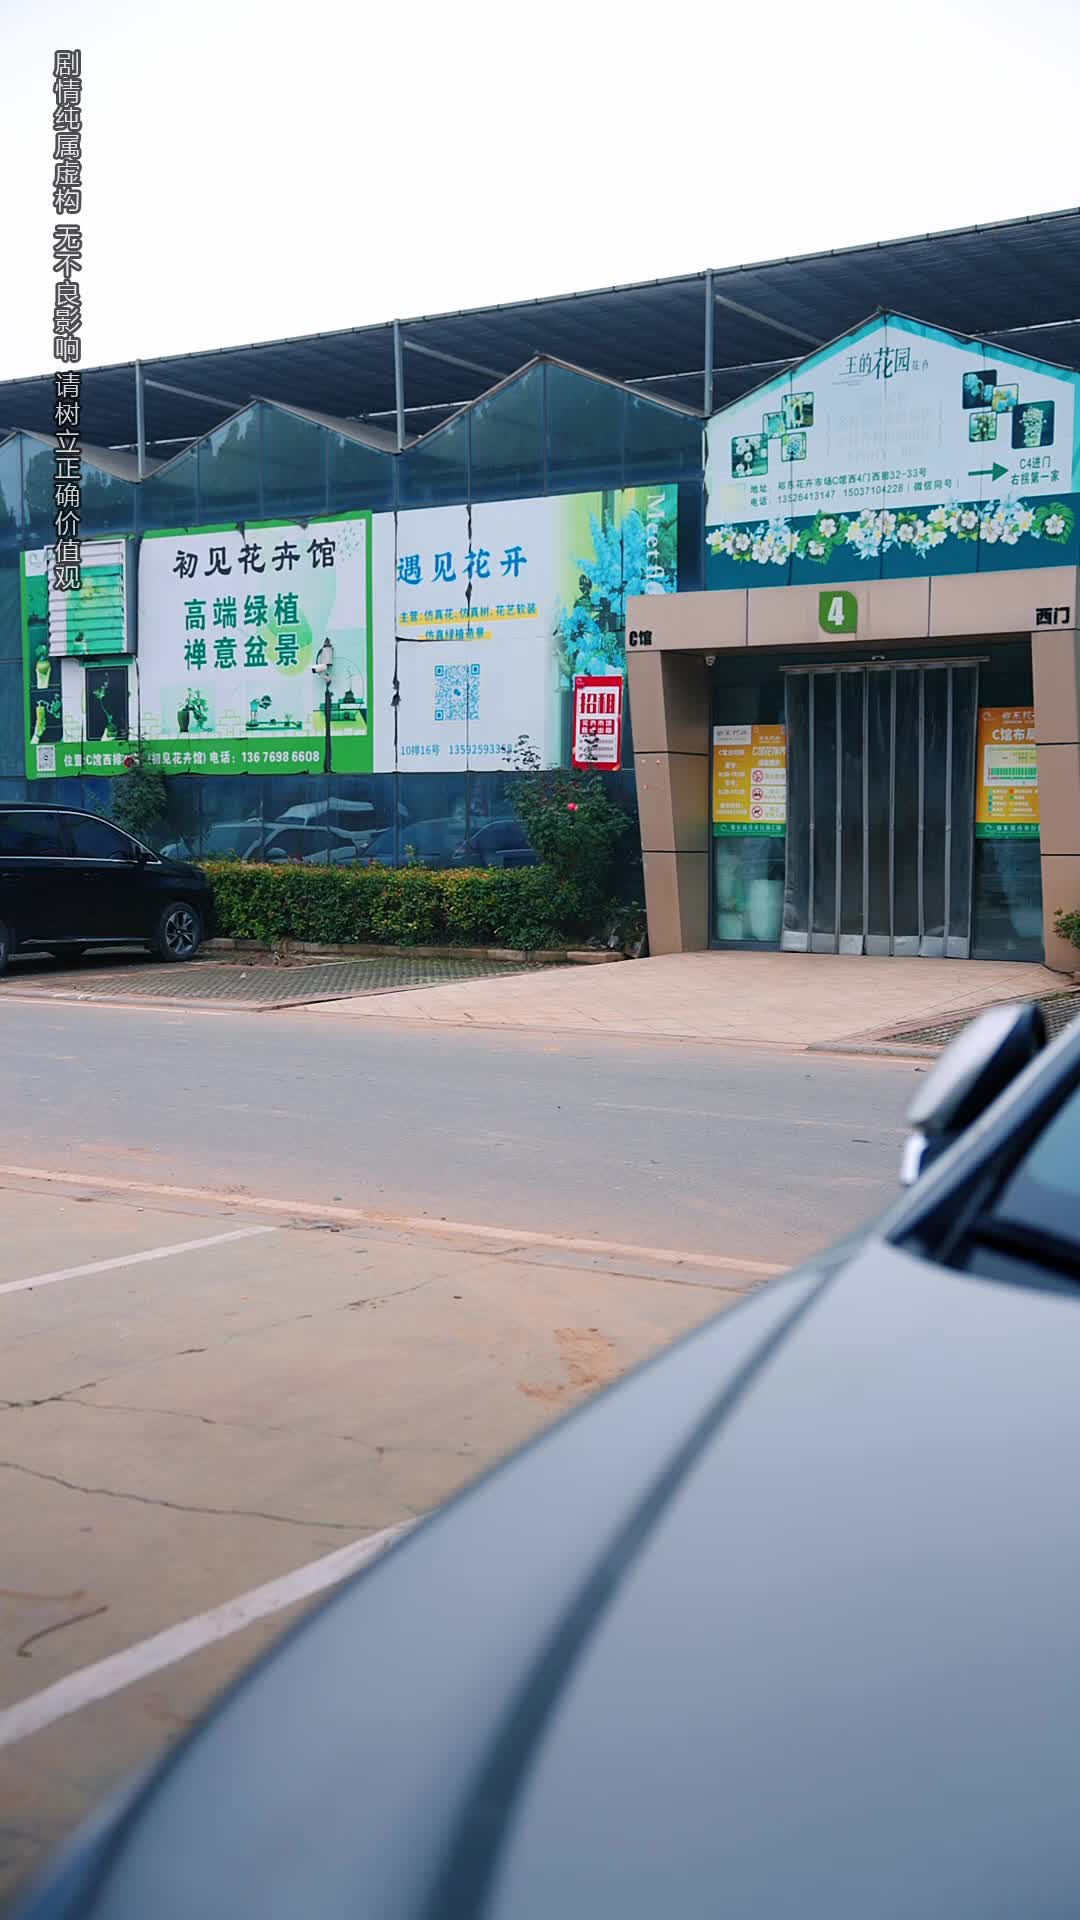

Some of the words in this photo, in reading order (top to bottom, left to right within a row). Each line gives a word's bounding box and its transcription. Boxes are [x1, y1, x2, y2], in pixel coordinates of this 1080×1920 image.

[844, 347, 911, 380] 王的花园
[1019, 455, 1051, 469] C4进门
[172, 537, 337, 579] 初见花卉馆
[396, 545, 528, 585] 遇见花开
[184, 592, 300, 631] 高端绿植
[827, 596, 845, 625] 4
[1035, 606, 1070, 626] 西门
[184, 633, 300, 670] 禅意盆景
[629, 630, 653, 647] C馆
[241, 751, 260, 763] 136
[262, 751, 289, 763] 7698
[291, 750, 320, 762] 6608
